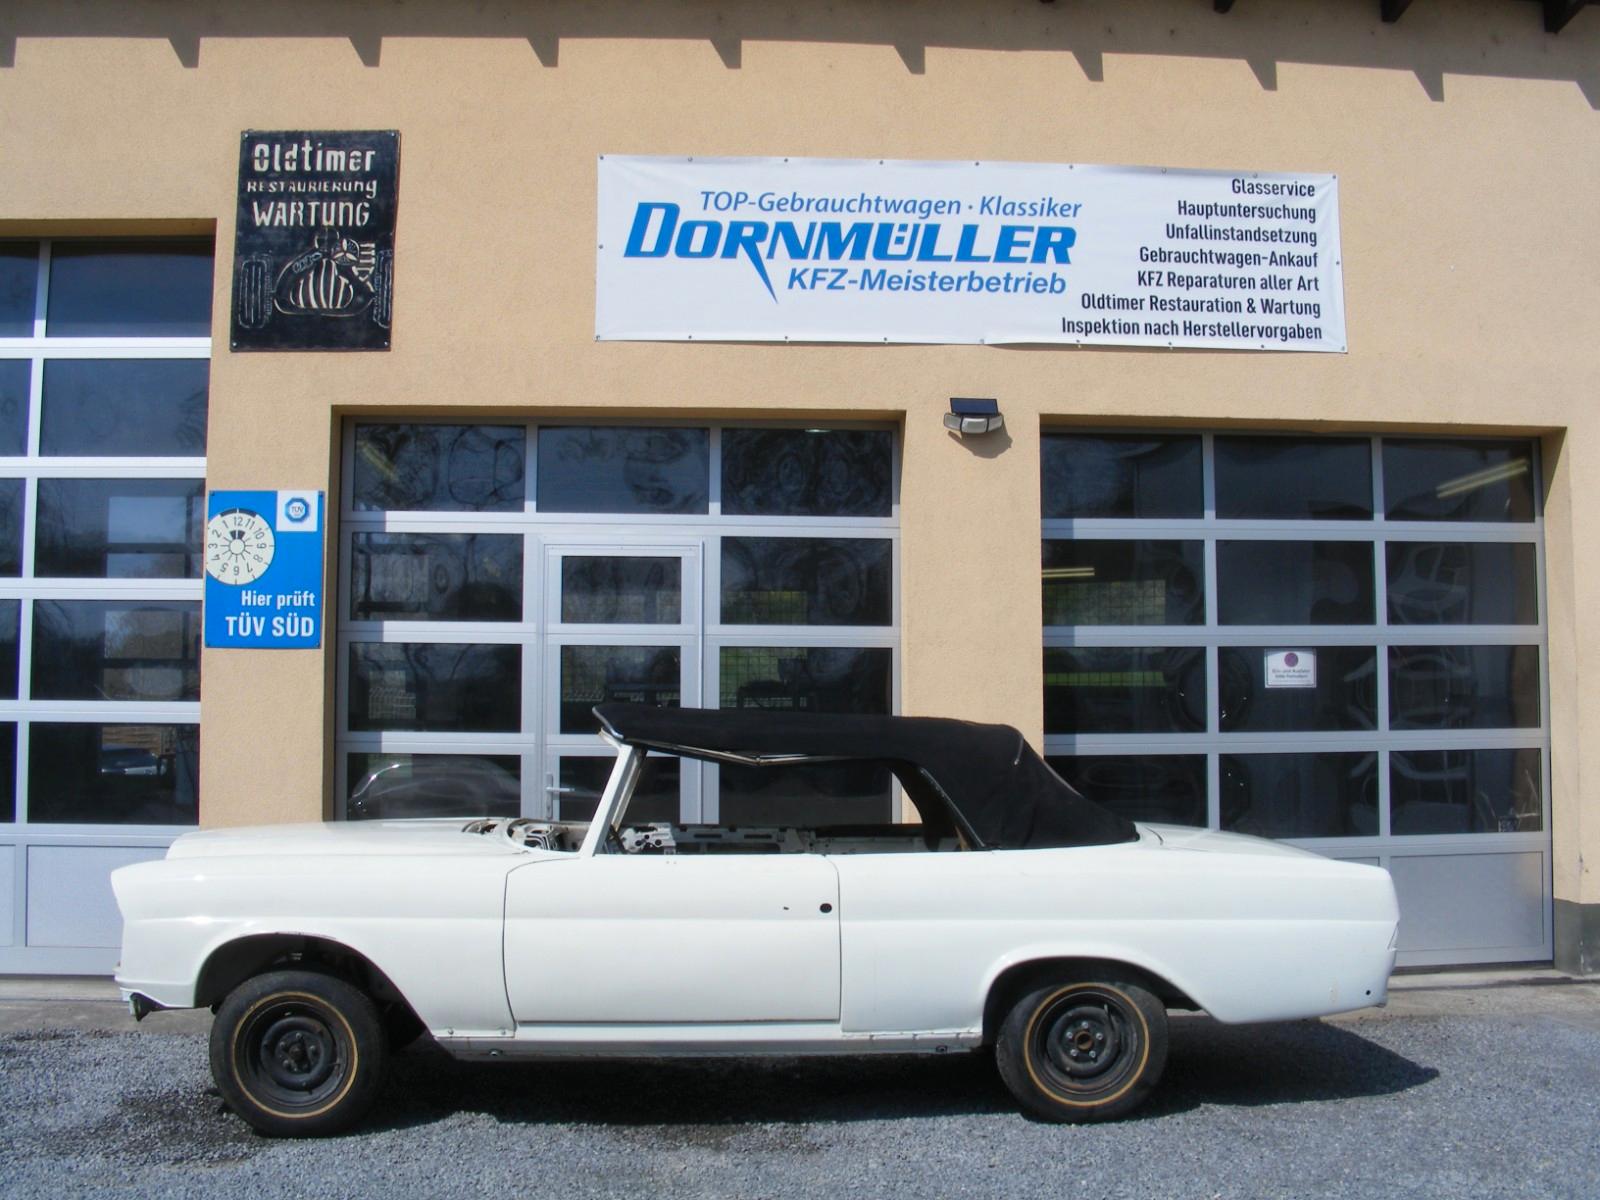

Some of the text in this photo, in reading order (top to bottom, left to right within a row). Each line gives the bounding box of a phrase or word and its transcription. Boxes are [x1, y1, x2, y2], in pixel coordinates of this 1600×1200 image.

[254, 139, 376, 172] Oldtimer
[1231, 178, 1316, 197] Glasservice
[700, 190, 1083, 219] TOP-Gebrauchtwagen Klassiker
[1177, 199, 1317, 223] Hauptuntersuchung
[1166, 223, 1318, 247] Unfallinstandsetzung
[1139, 246, 1318, 268] Gebrauchtwagen-Ankauf
[786, 267, 1067, 295] KFZ-Meisterbetrieb
[1137, 270, 1320, 291] KFZ Reparaturen aller Art
[1081, 293, 1321, 319] Oldtimer Restauration & Wartung
[1062, 317, 1323, 342] Inspektion nach Herstellervorgaben
[233, 516, 243, 527] 12
[245, 518, 256, 530] 11
[241, 590, 315, 610] Hier prüft
[225, 612, 315, 637] TÜV SÜD
